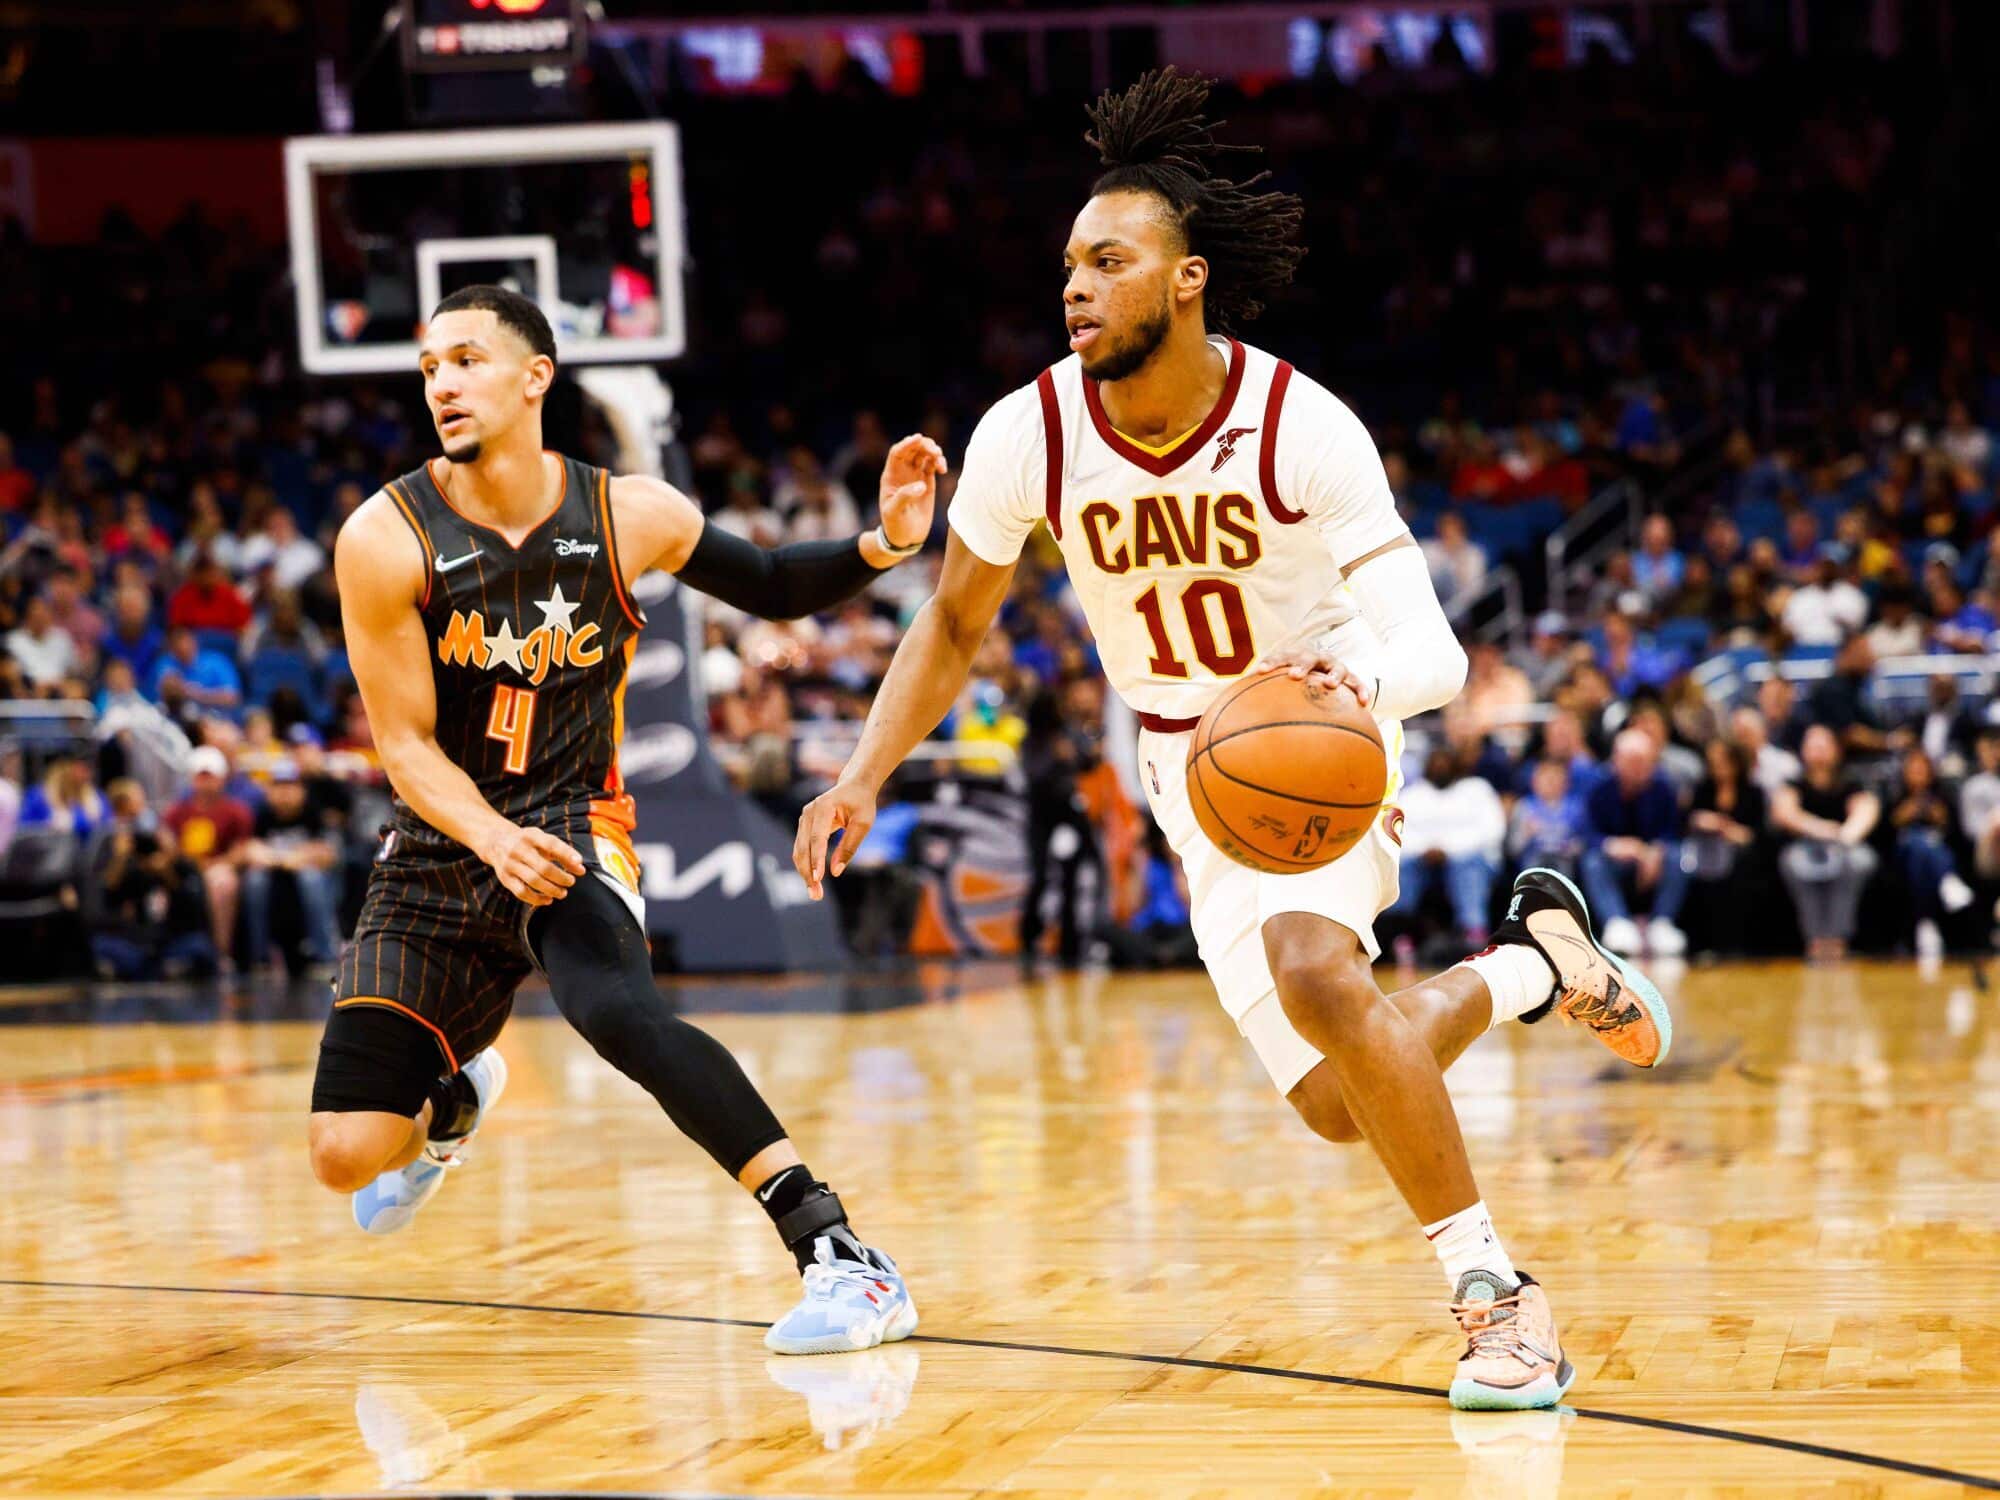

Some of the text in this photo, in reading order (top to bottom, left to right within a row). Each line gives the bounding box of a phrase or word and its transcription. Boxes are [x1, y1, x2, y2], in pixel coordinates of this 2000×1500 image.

[553, 538, 599, 558] Disney
[1079, 493, 1262, 575] CAVS
[1134, 577, 1256, 679] 10
[486, 683, 538, 775] 4
